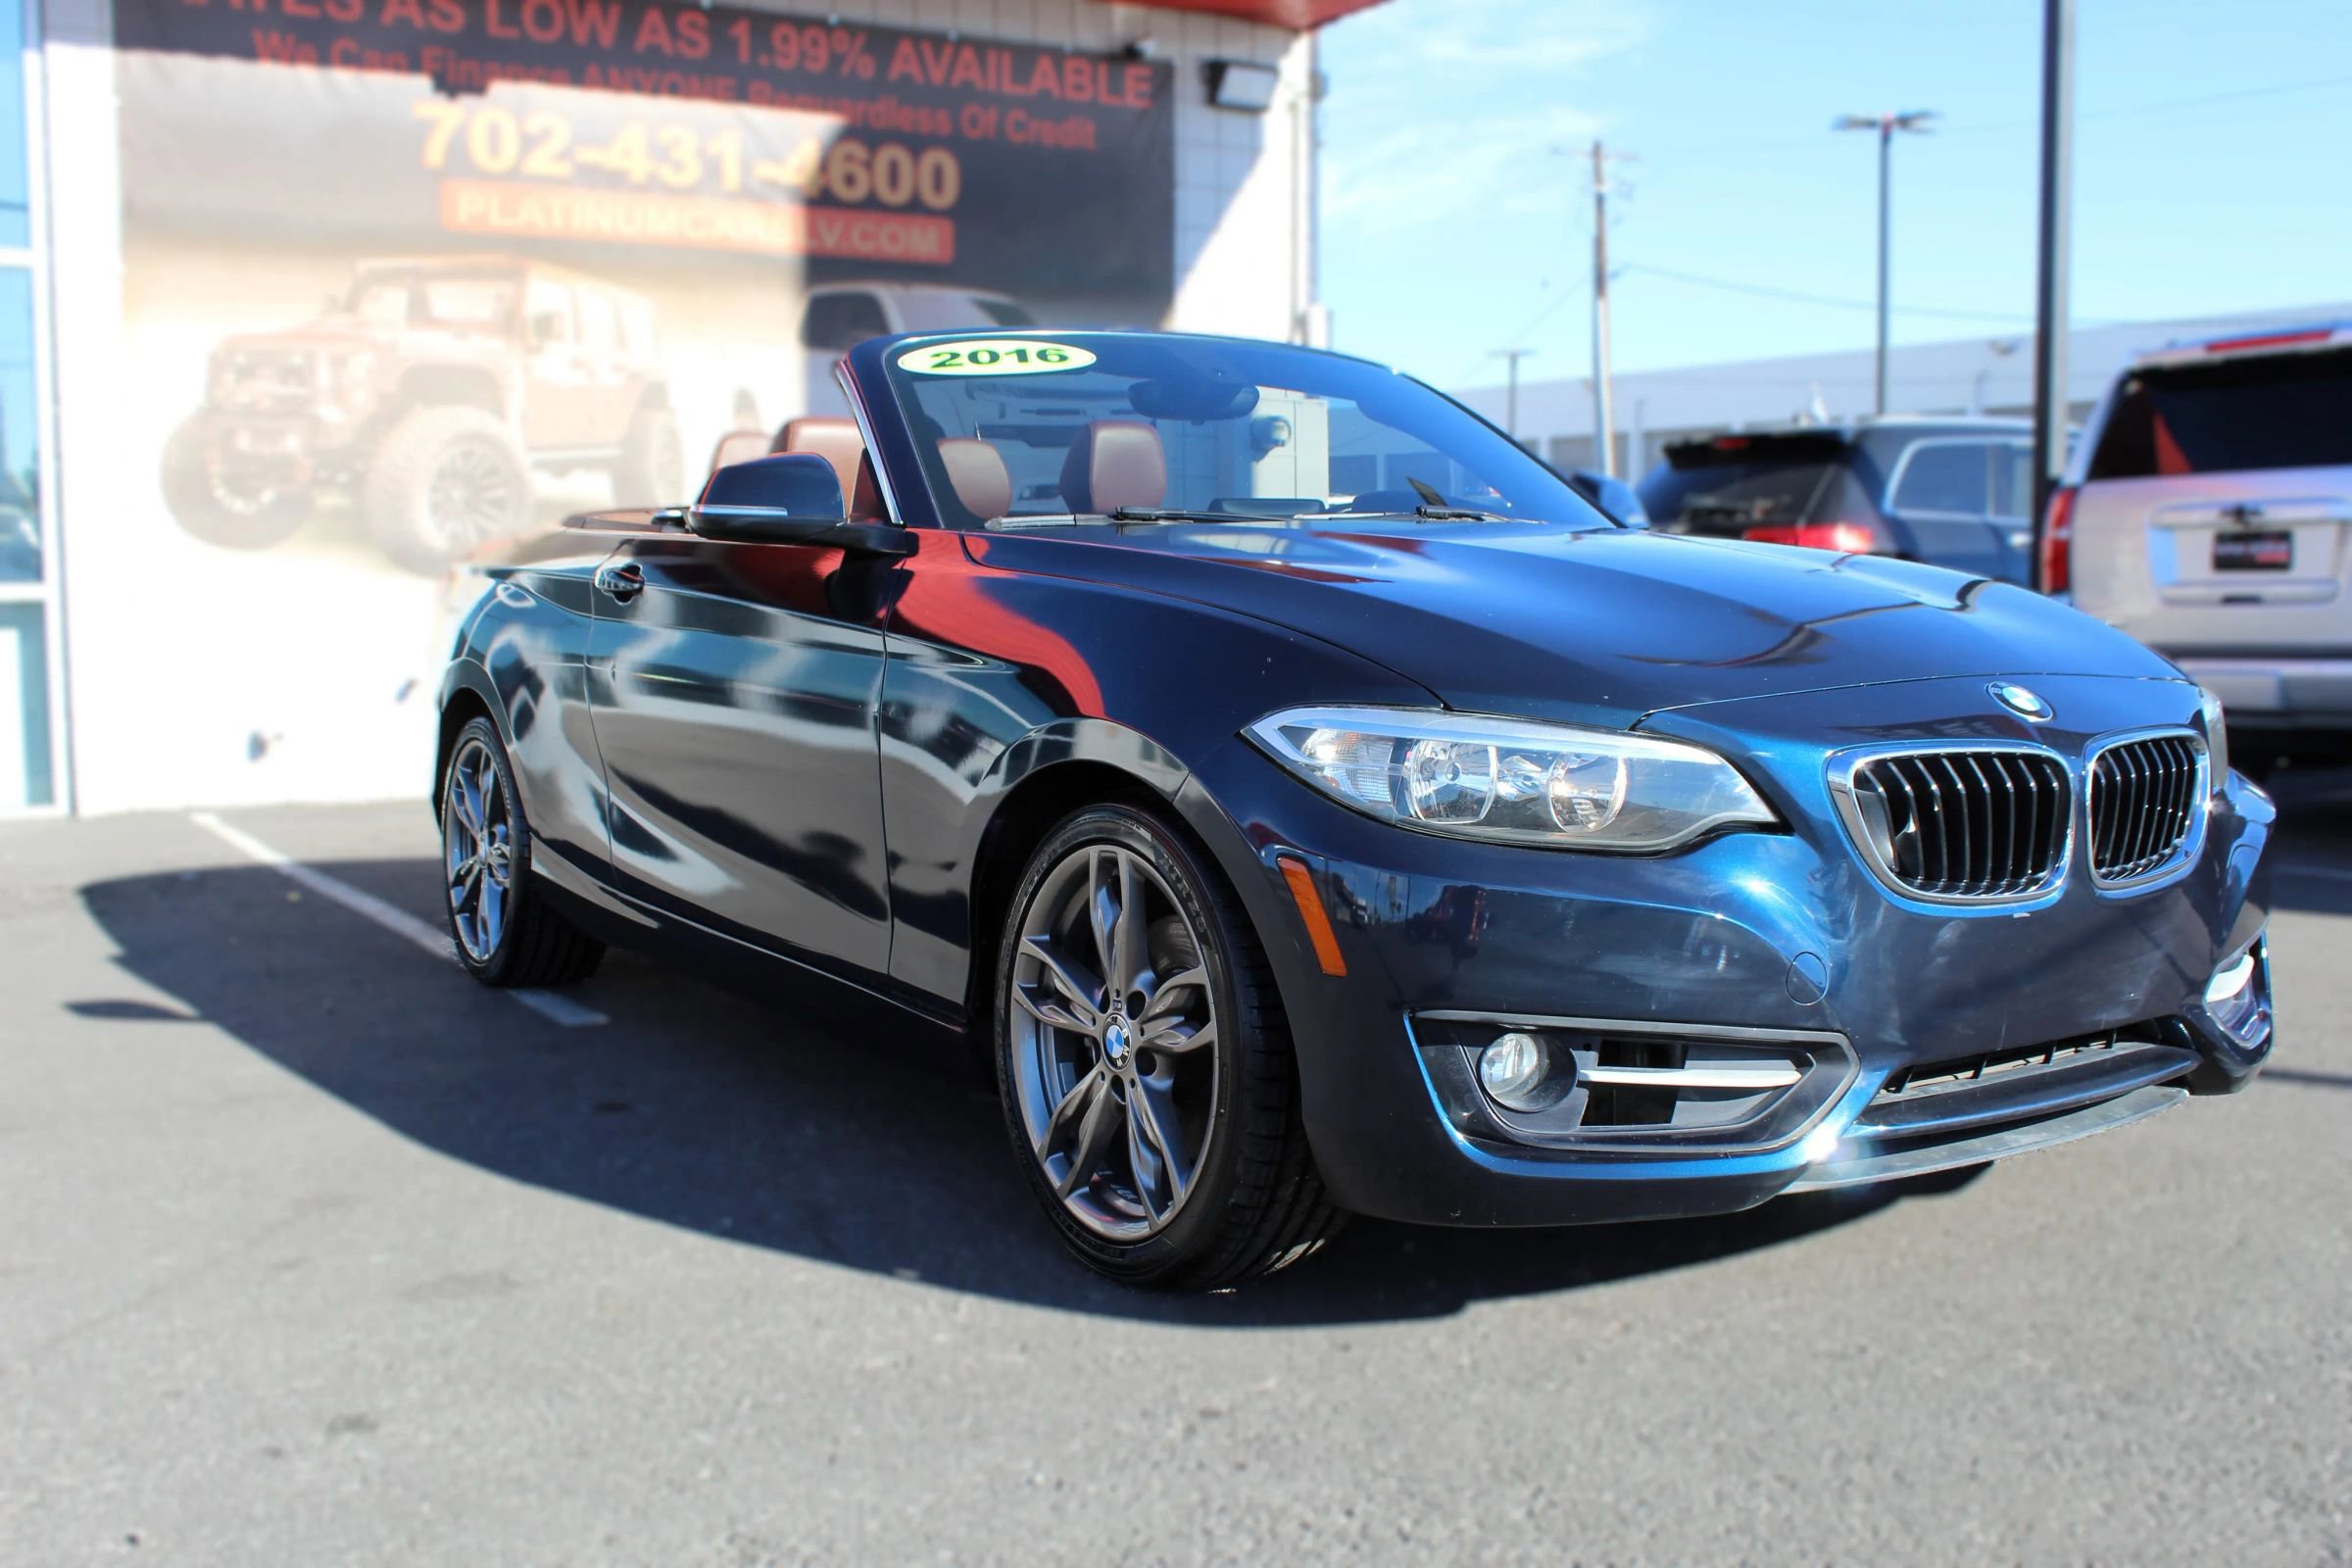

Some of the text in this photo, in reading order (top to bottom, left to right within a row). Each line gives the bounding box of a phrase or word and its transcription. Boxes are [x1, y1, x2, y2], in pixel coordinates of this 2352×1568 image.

[380, 0, 466, 32] AS
[488, 0, 620, 50] LOW
[634, 8, 710, 59] AS
[728, 19, 877, 79] 1.99%
[888, 37, 1154, 110] AVAILABLE
[413, 101, 960, 210] 702-431-4600
[582, 63, 737, 104] ANYONE
[960, 103, 999, 140] Of
[1005, 109, 1097, 151] Credit
[930, 347, 1069, 369] 2016
